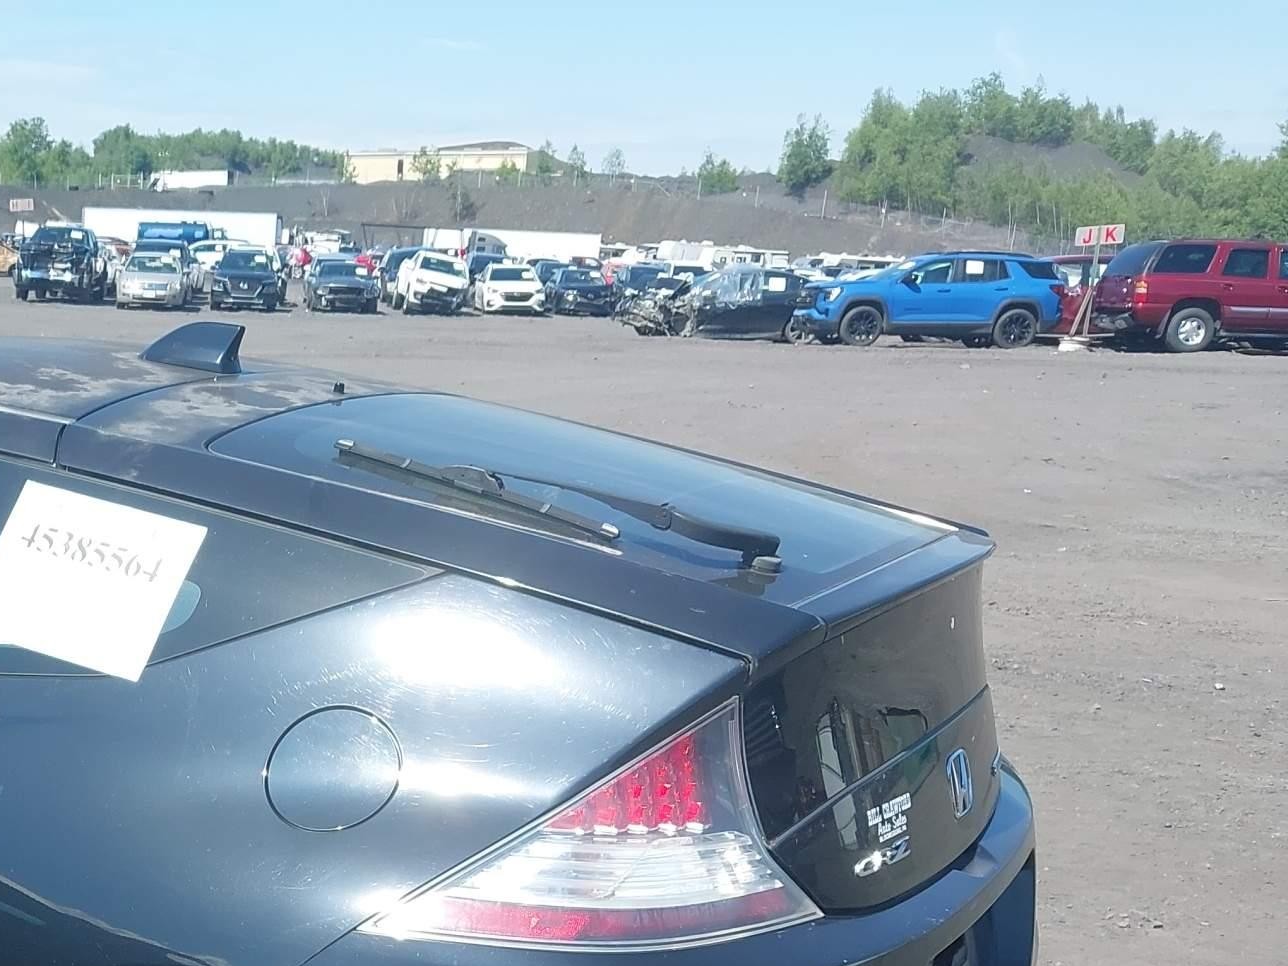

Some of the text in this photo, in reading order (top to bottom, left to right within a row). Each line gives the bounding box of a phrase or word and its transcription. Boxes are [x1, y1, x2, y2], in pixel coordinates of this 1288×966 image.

[1082, 226, 1118, 244] J K
[21, 524, 162, 582] 45385564
